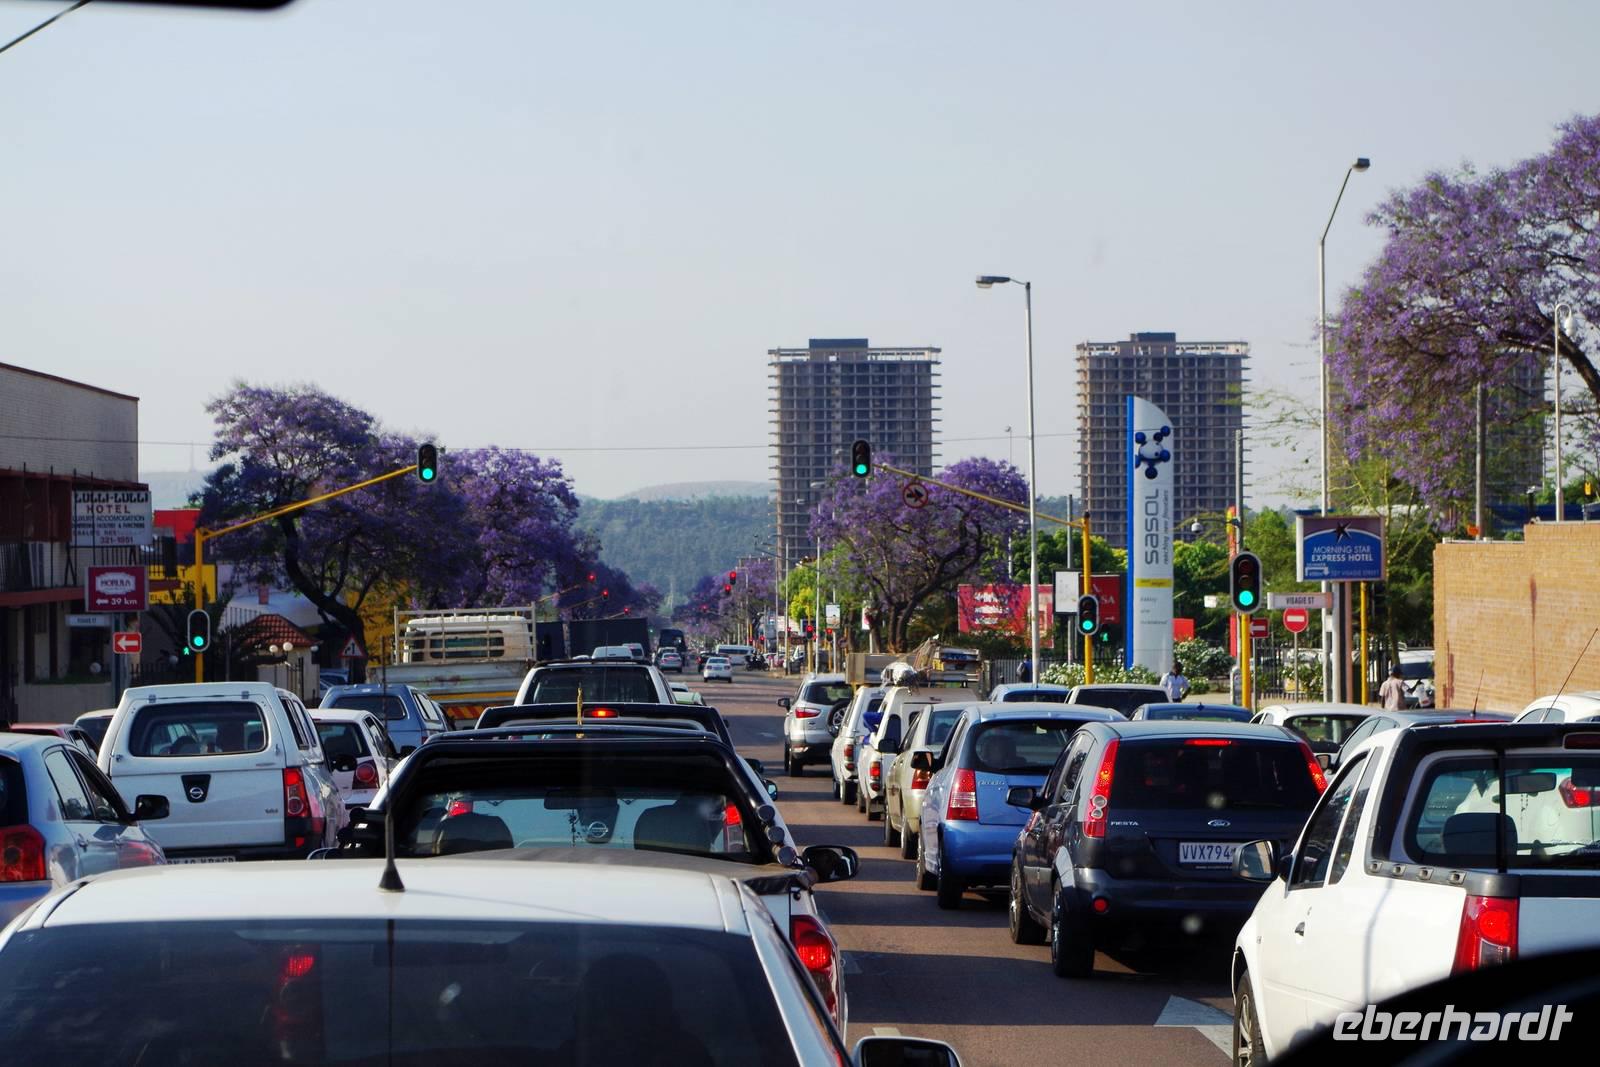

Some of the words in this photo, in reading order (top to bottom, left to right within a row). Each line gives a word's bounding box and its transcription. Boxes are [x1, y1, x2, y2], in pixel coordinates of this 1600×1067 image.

[86, 505, 131, 514] HOTEL
[1312, 545, 1353, 554] MORNING
[1354, 545, 1371, 554] STAR
[1311, 553, 1346, 562] EXPRESS
[1348, 553, 1373, 562] HOTEL
[111, 597, 122, 606] 39
[124, 597, 138, 605] km
[1285, 596, 1307, 605] VISAGIE
[1308, 596, 1315, 605] ST
